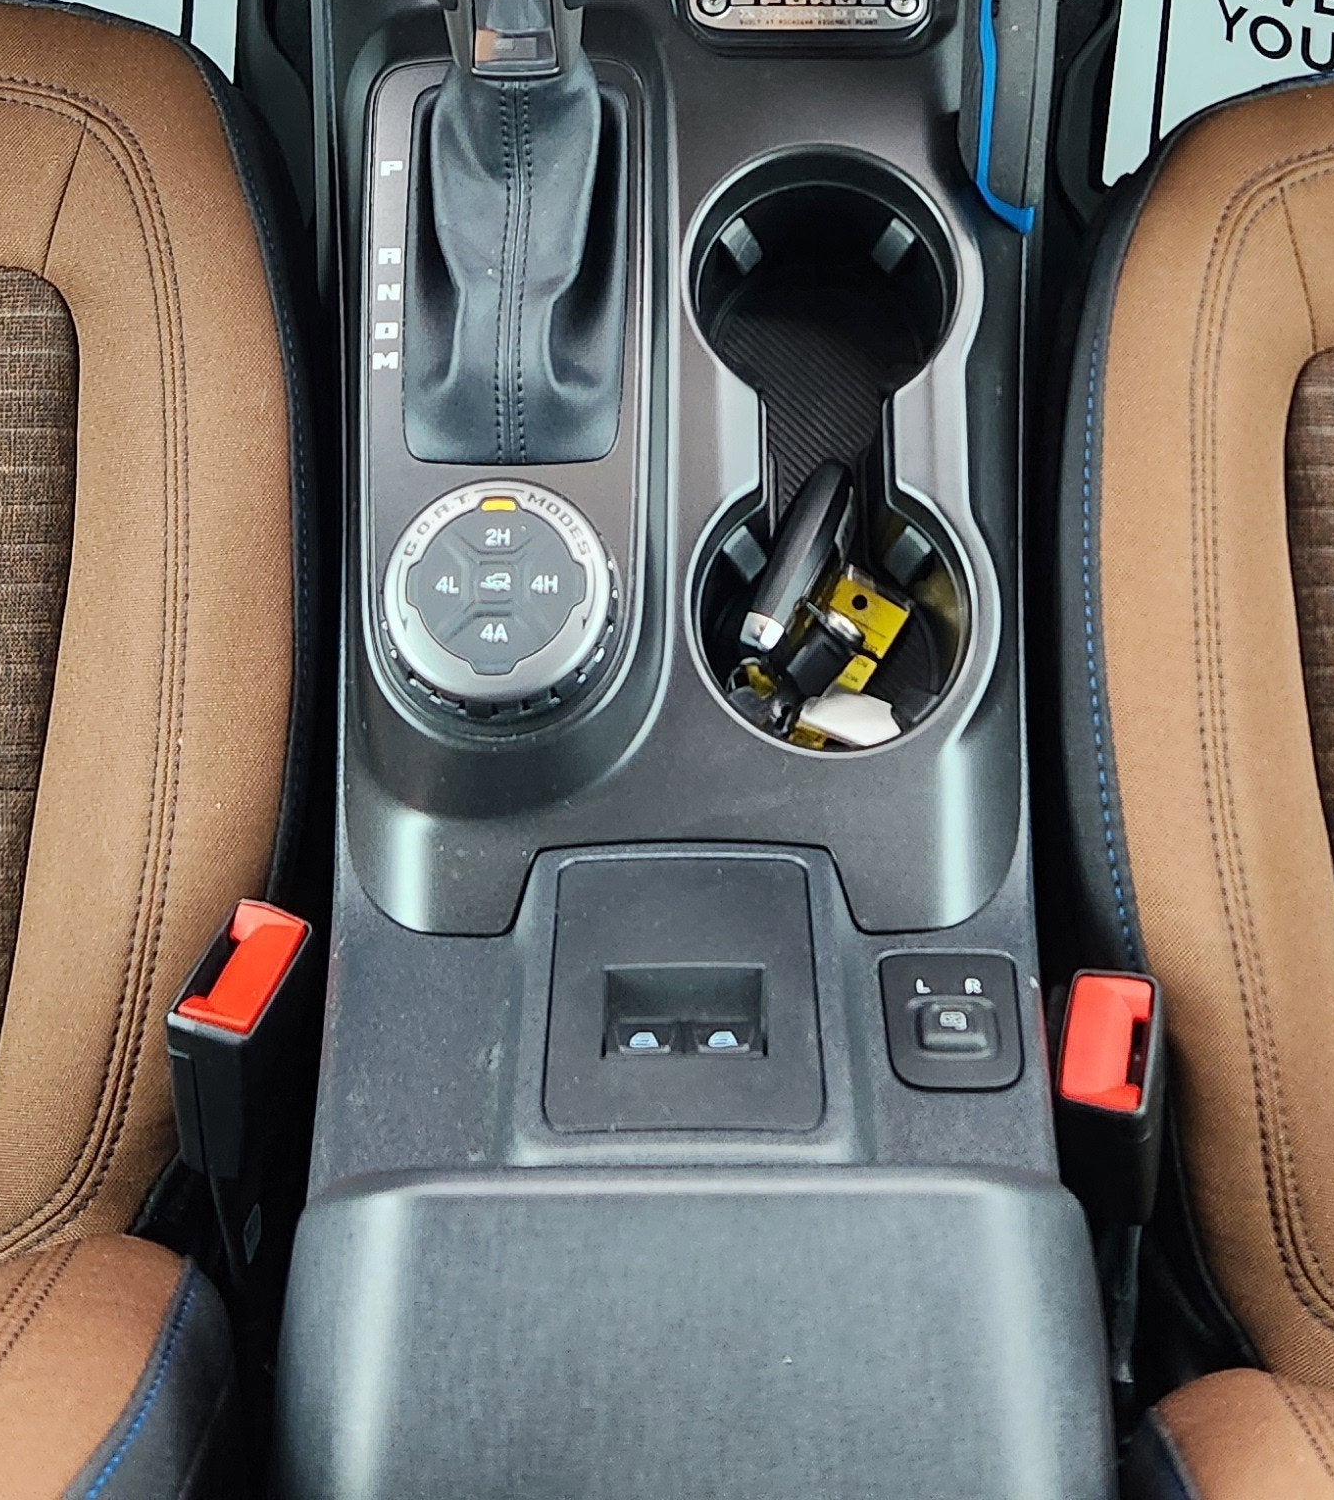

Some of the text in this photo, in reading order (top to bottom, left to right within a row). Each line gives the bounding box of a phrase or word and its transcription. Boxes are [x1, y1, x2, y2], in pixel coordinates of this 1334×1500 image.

[380, 160, 404, 177] P
[377, 283, 401, 301] N
[374, 322, 399, 340] D
[372, 351, 399, 370] M
[527, 492, 591, 556] MODES
[484, 527, 511, 547] 2H
[435, 575, 459, 595] 4L
[530, 574, 559, 594] 4H
[479, 622, 509, 643] 4A
[915, 978, 932, 995] L
[964, 977, 983, 995] R
